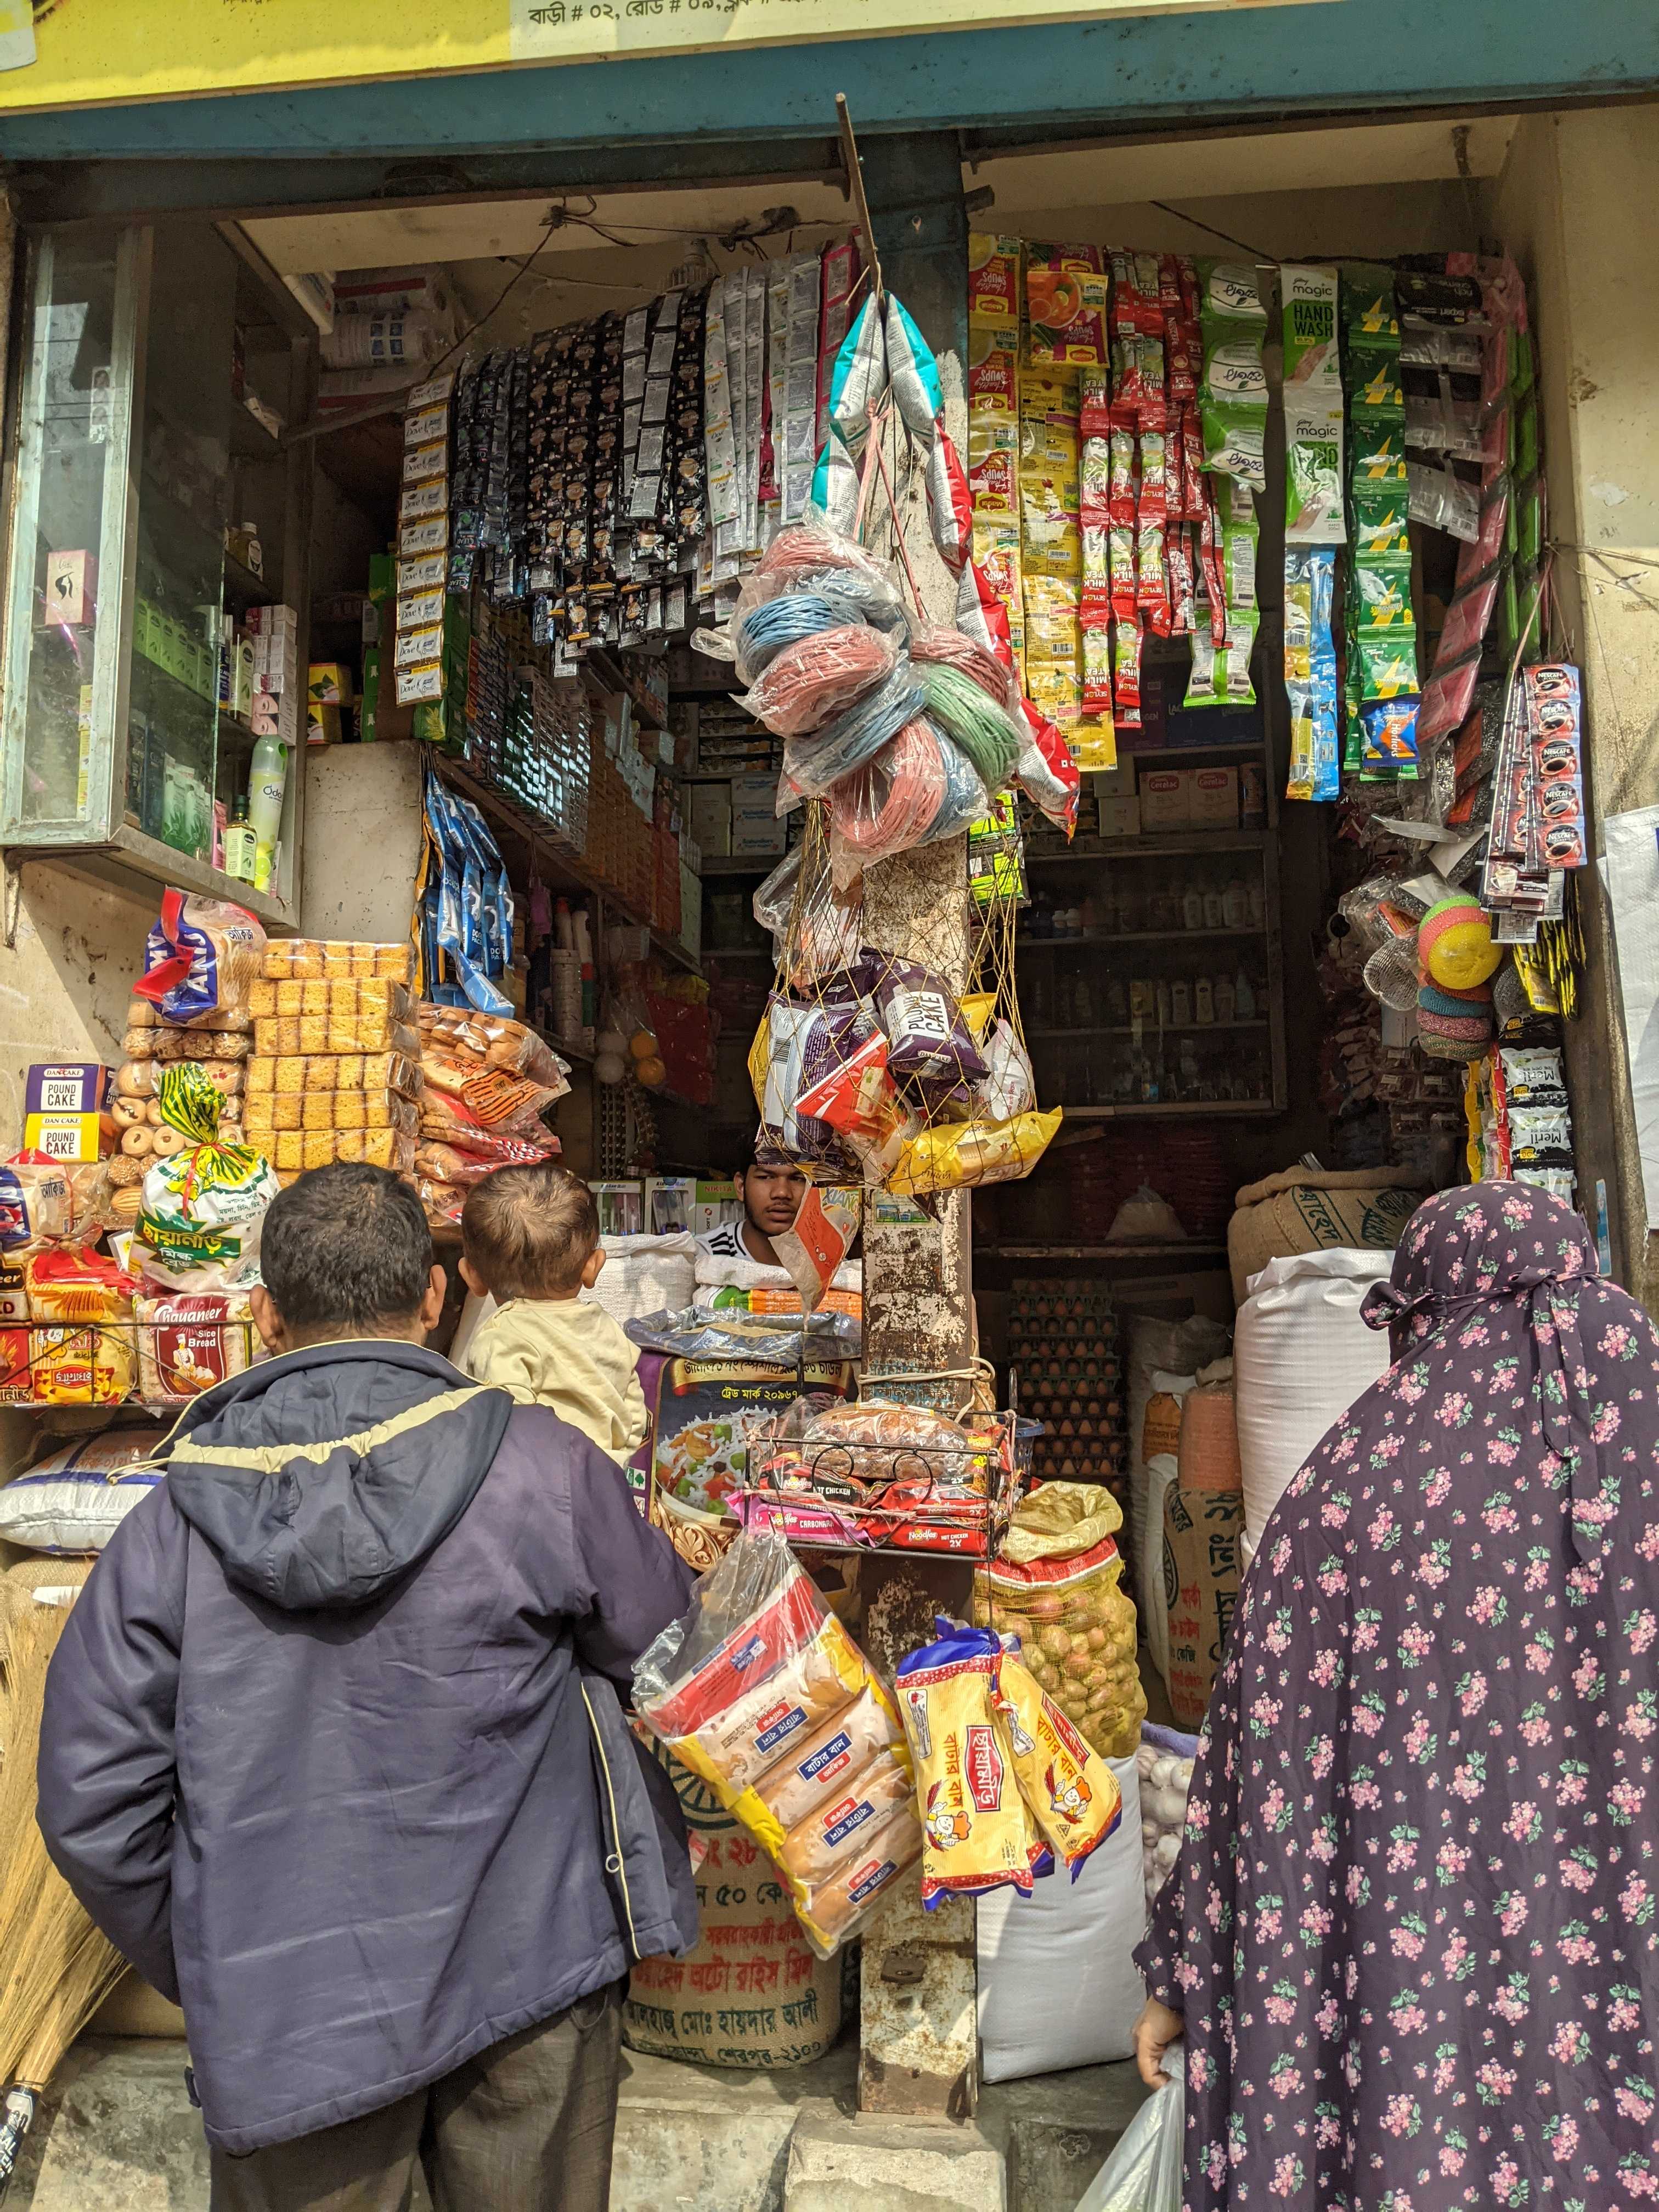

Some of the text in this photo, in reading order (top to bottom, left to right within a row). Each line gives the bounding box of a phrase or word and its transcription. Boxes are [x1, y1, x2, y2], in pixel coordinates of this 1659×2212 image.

[1293, 283, 1332, 297] magic
[1295, 304, 1333, 321] HAND
[1295, 321, 1333, 337] WASH
[1297, 425, 1338, 438] magic
[1142, 476, 1164, 484] MILK
[1142, 562, 1160, 572] TEA
[1086, 570, 1104, 579] TEA
[1140, 571, 1161, 580] MILK
[1084, 579, 1106, 588] MILK
[399, 647, 415, 657] Dove
[1121, 659, 1137, 668] TEA
[1086, 667, 1105, 675] TEA
[1085, 675, 1108, 685] MILK
[399, 685, 415, 695] Dove
[1119, 682, 1138, 692] SEYLON
[1390, 723, 1401, 757] Horlicks
[1150, 780, 1177, 788] Cerelac
[224, 927, 253, 940] আকিজ
[904, 995, 926, 1030] POUND
[920, 995, 946, 1034] CAKE
[934, 1053, 950, 1063] CAKE
[1523, 1070, 1555, 1082] Meril
[48, 1085, 76, 1093] POUND
[48, 1094, 75, 1105] CAKE
[47, 1132, 75, 1141] POUND
[1531, 1132, 1561, 1145] Meril
[47, 1142, 74, 1154] CAKE
[40, 1177, 65, 1198] আকিজ
[143, 1220, 222, 1254] ছায়ানীড়
[198, 1329, 216, 1338] Slice
[188, 1338, 216, 1347] Bread
[55, 1370, 93, 1385] ছায়ানীড়
[721, 1386, 798, 1401] ট্রেড মার্ক ২০৯৬৭
[785, 1479, 812, 1489] Noodles
[826, 1487, 850, 1496] CHICKEN
[799, 1520, 834, 1529] CARBONARA
[909, 1530, 937, 1541] Noodles
[949, 1540, 962, 1548] 2X
[763, 1707, 783, 1727] আকিজ
[761, 1712, 802, 1747] বাটার বান
[1046, 1699, 1085, 1764] ছায়ানীড়
[1037, 1716, 1077, 1781] বাটার বান
[805, 1739, 845, 1774] বাটার বান
[823, 1757, 845, 1778] আকিজ
[944, 1731, 963, 1808] বাটার বান
[973, 1731, 998, 1805] ছায়ানীড়
[830, 1802, 851, 1822] আকিজ
[830, 1806, 869, 1843] বাটার বান
[854, 1866, 891, 1899] বাটার বান
[716, 1884, 746, 1906] ৫০
[717, 2007, 777, 2041] হায়দার
[781, 1988, 818, 2028] আলী
